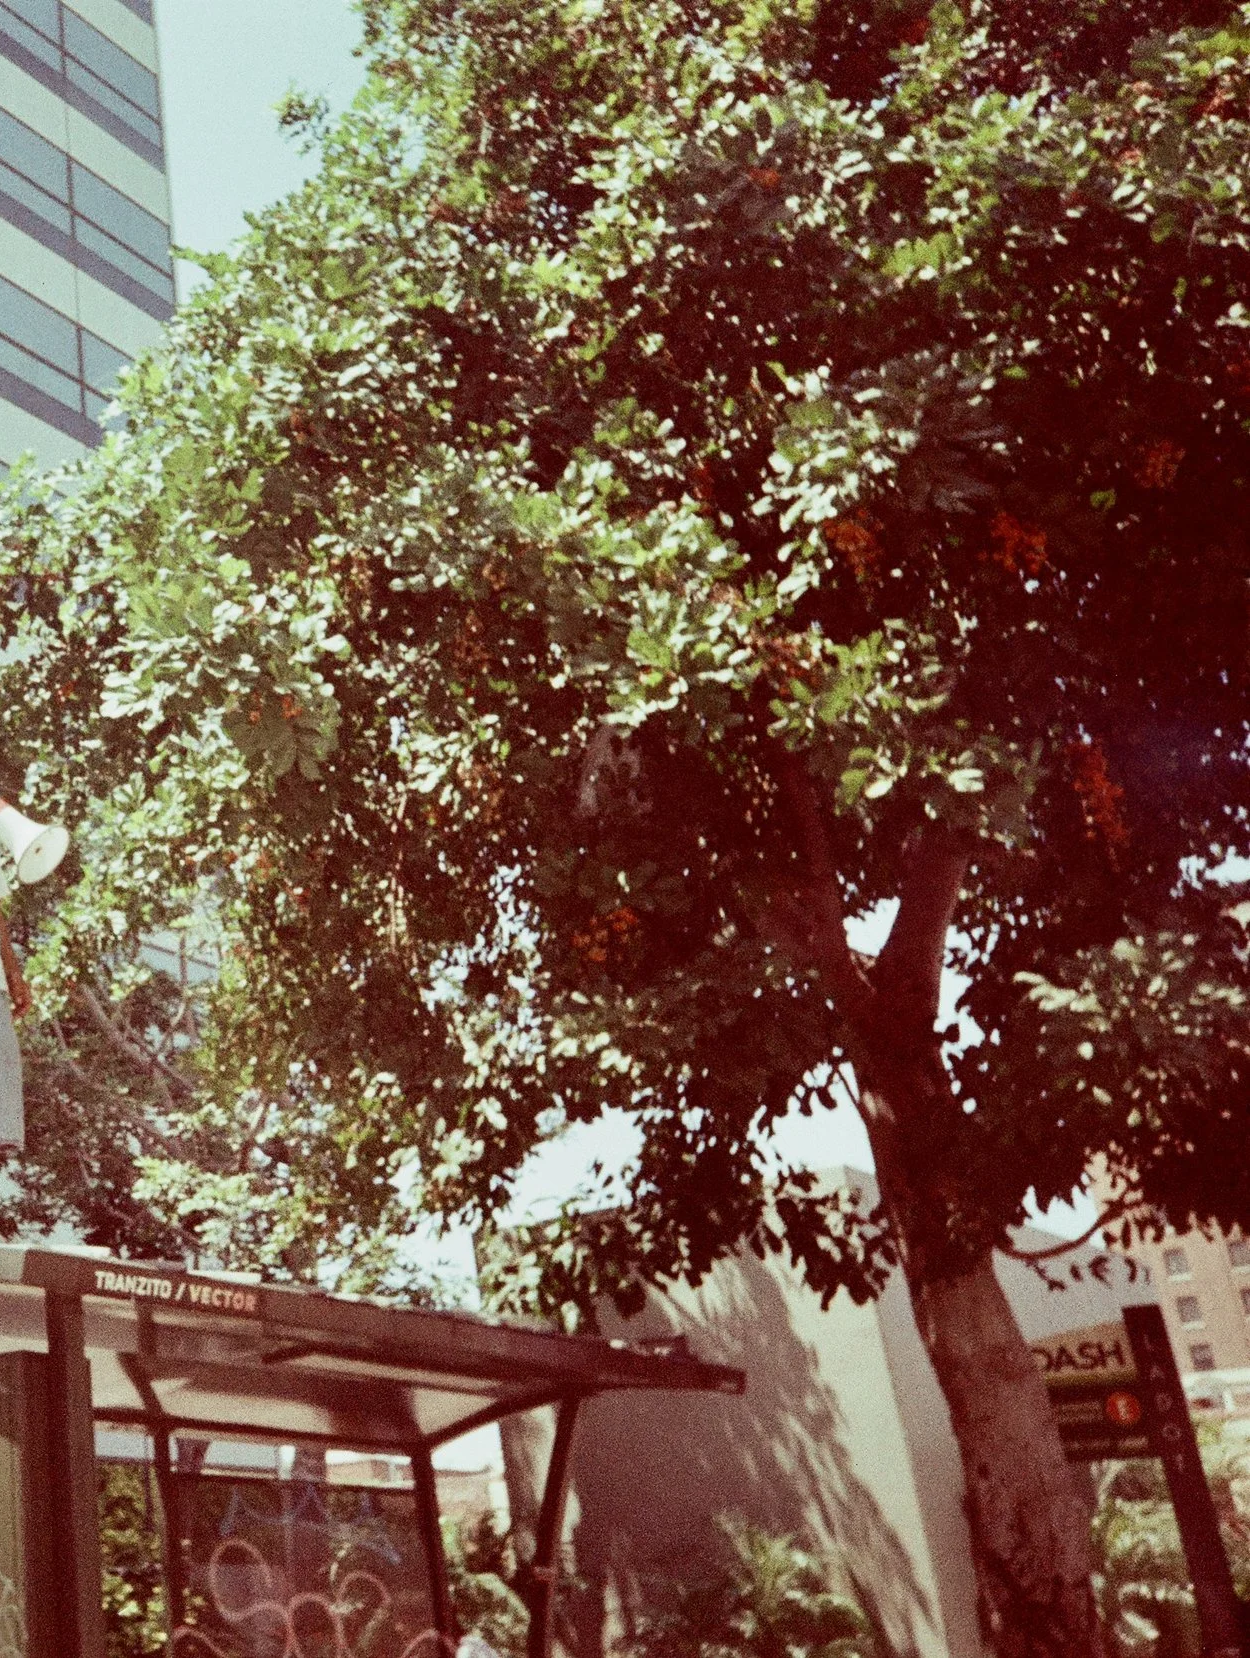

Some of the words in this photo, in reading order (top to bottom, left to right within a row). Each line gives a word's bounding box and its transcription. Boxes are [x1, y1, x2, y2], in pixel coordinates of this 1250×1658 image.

[94, 1270, 172, 1300] TRANZITO
[188, 1284, 256, 1312] VECTOR
[1032, 1340, 1126, 1372] DASH
